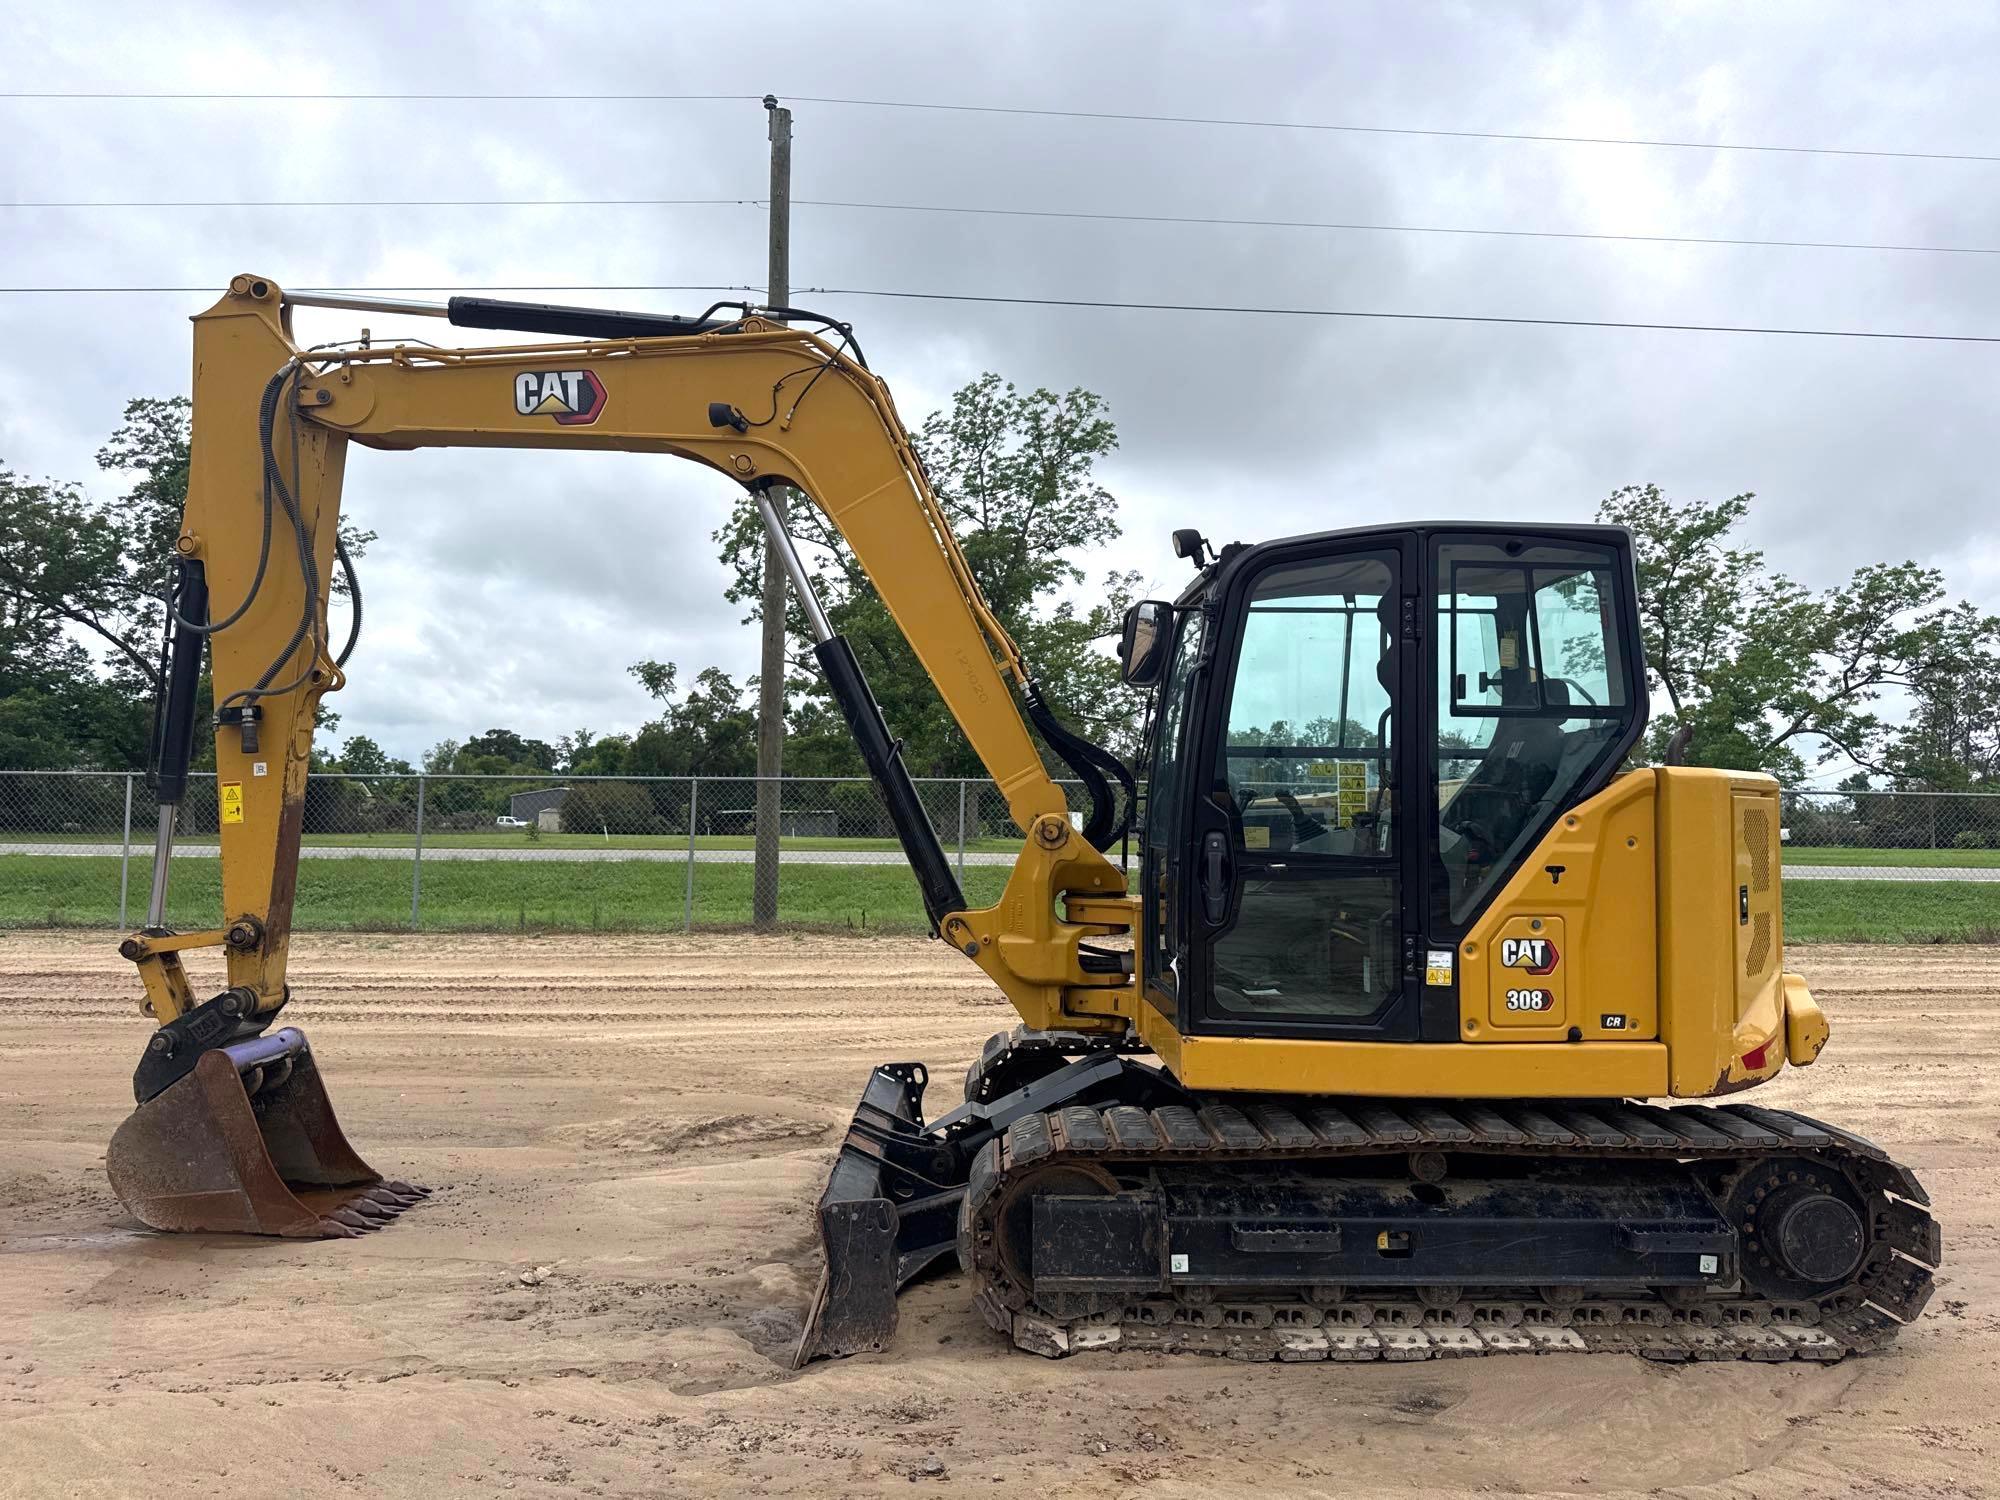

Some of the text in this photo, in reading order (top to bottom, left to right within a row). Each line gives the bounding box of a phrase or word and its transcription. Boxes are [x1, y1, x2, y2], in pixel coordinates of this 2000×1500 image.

[516, 371, 583, 414] CAT
[1502, 939, 1545, 967] CAT
[1507, 990, 1542, 1009] 308
[1606, 1017, 1621, 1027] CR
